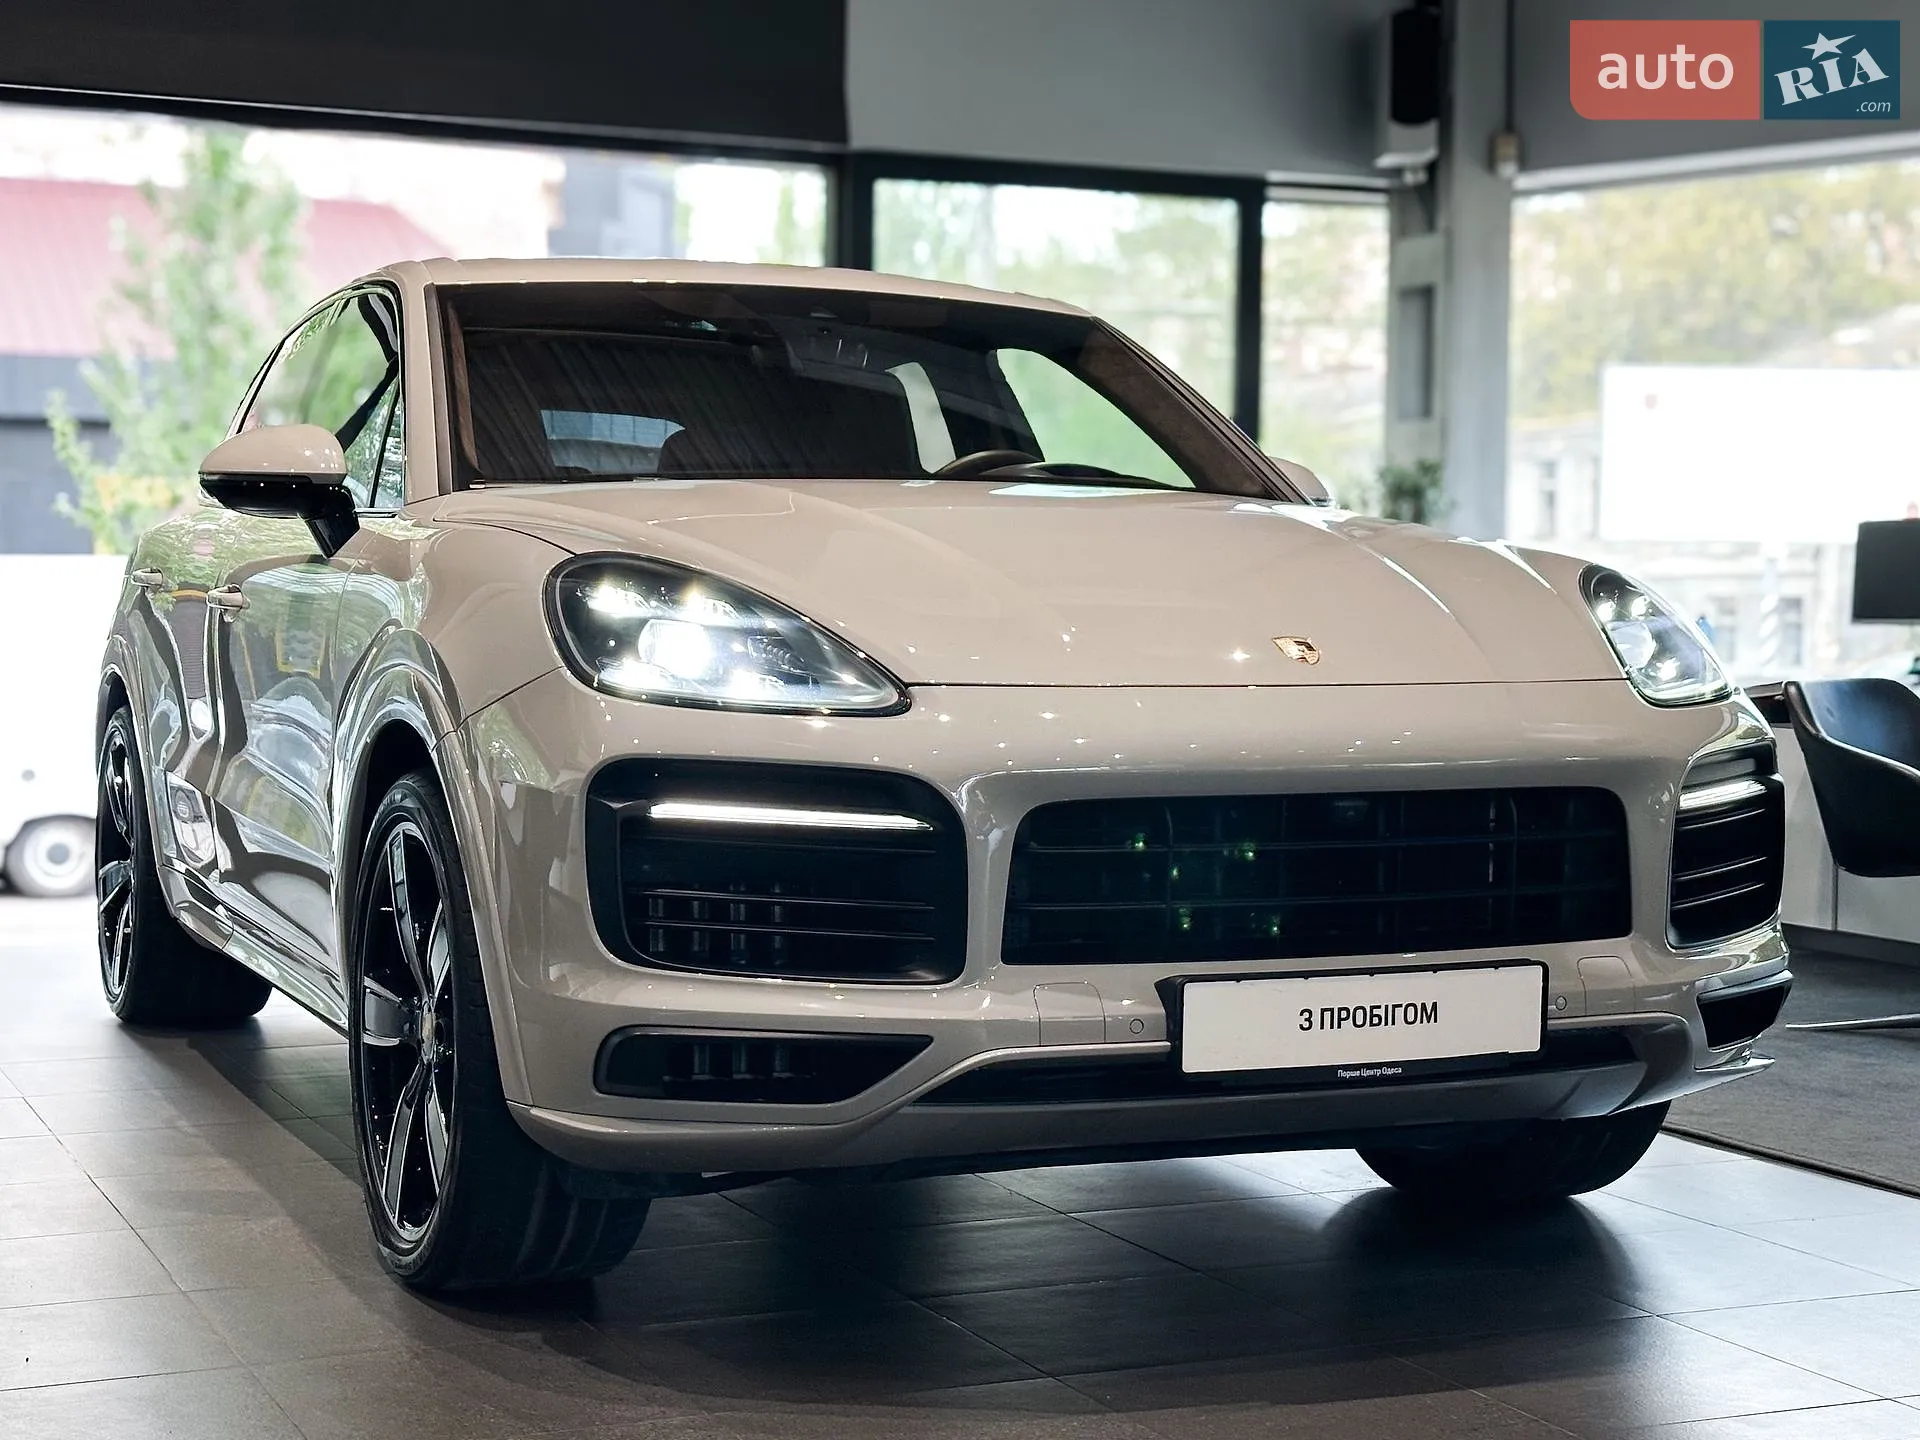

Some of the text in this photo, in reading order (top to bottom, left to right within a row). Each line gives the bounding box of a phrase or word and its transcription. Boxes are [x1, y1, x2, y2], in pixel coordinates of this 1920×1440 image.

[1319, 1001, 1438, 1030] ПРОБІГОМ
[1337, 1066, 1402, 1079] Порше Центр Одеса
